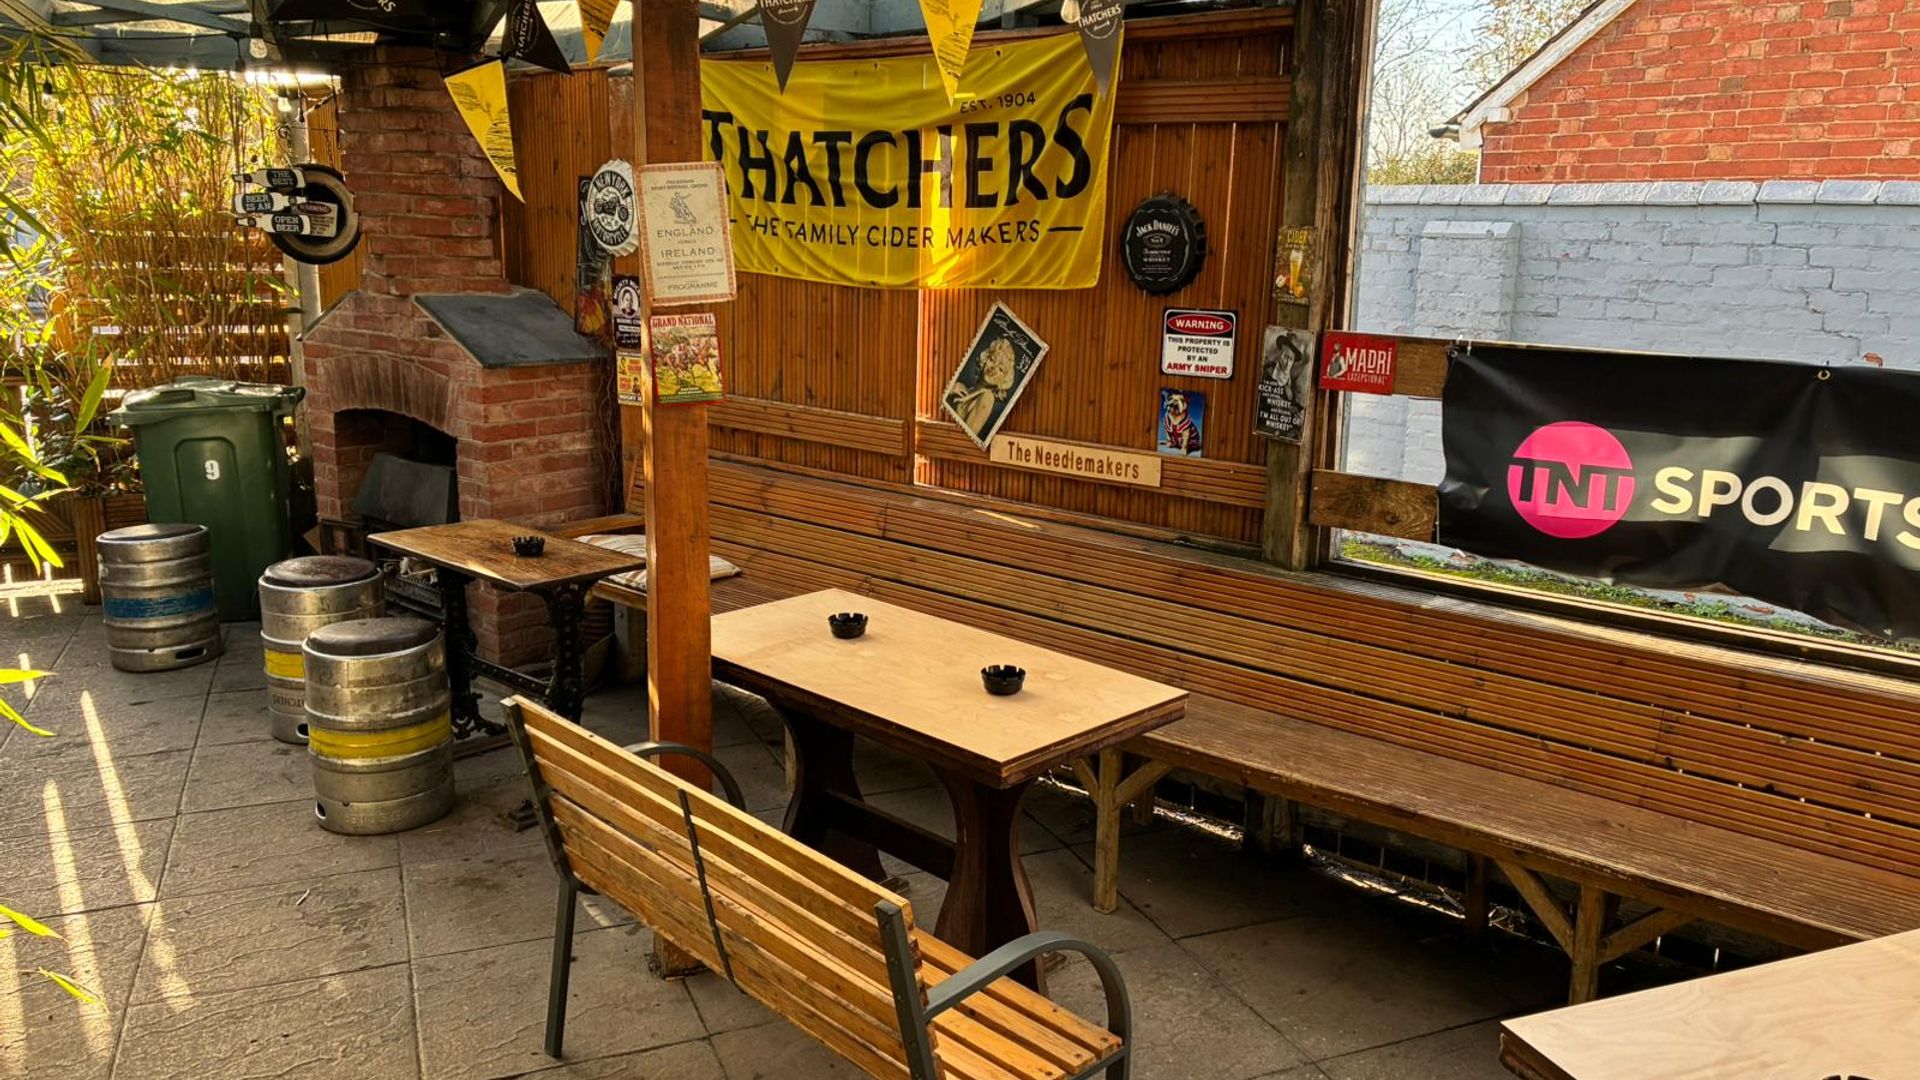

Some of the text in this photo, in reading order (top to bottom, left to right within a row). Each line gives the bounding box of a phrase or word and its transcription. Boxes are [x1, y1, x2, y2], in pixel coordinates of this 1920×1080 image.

[1078, 3, 1121, 27] THATCHERS
[959, 92, 1037, 114] EST. 1904
[702, 94, 1093, 209] THATCHERS
[272, 169, 291, 178] THE
[594, 171, 631, 198] NEW YORK
[245, 193, 269, 203] BEER
[245, 203, 272, 211] IS AN
[274, 215, 299, 224] OPEN
[276, 223, 299, 232] BEER
[592, 217, 628, 245] MOTORCYCLE
[657, 225, 714, 238] ENGLAND
[1136, 223, 1153, 238] JACK
[787, 220, 860, 246] FAMILY
[867, 226, 933, 249] CIDER
[946, 220, 1040, 248] MAKERS
[1287, 230, 1308, 245] CIDER
[661, 246, 715, 258] IRELAND
[668, 281, 718, 292] PROGRAMME
[652, 314, 714, 328] GRAND NATIONAL
[1175, 319, 1224, 331] WARNING
[1178, 346, 1219, 354] PROTECTED
[1167, 362, 1228, 374] ARMY SNIPER
[1280, 415, 1292, 423] OUT
[1008, 441, 1140, 479] The Needlemakers
[205, 459, 220, 480] 9
[1509, 457, 1634, 513] TNT
